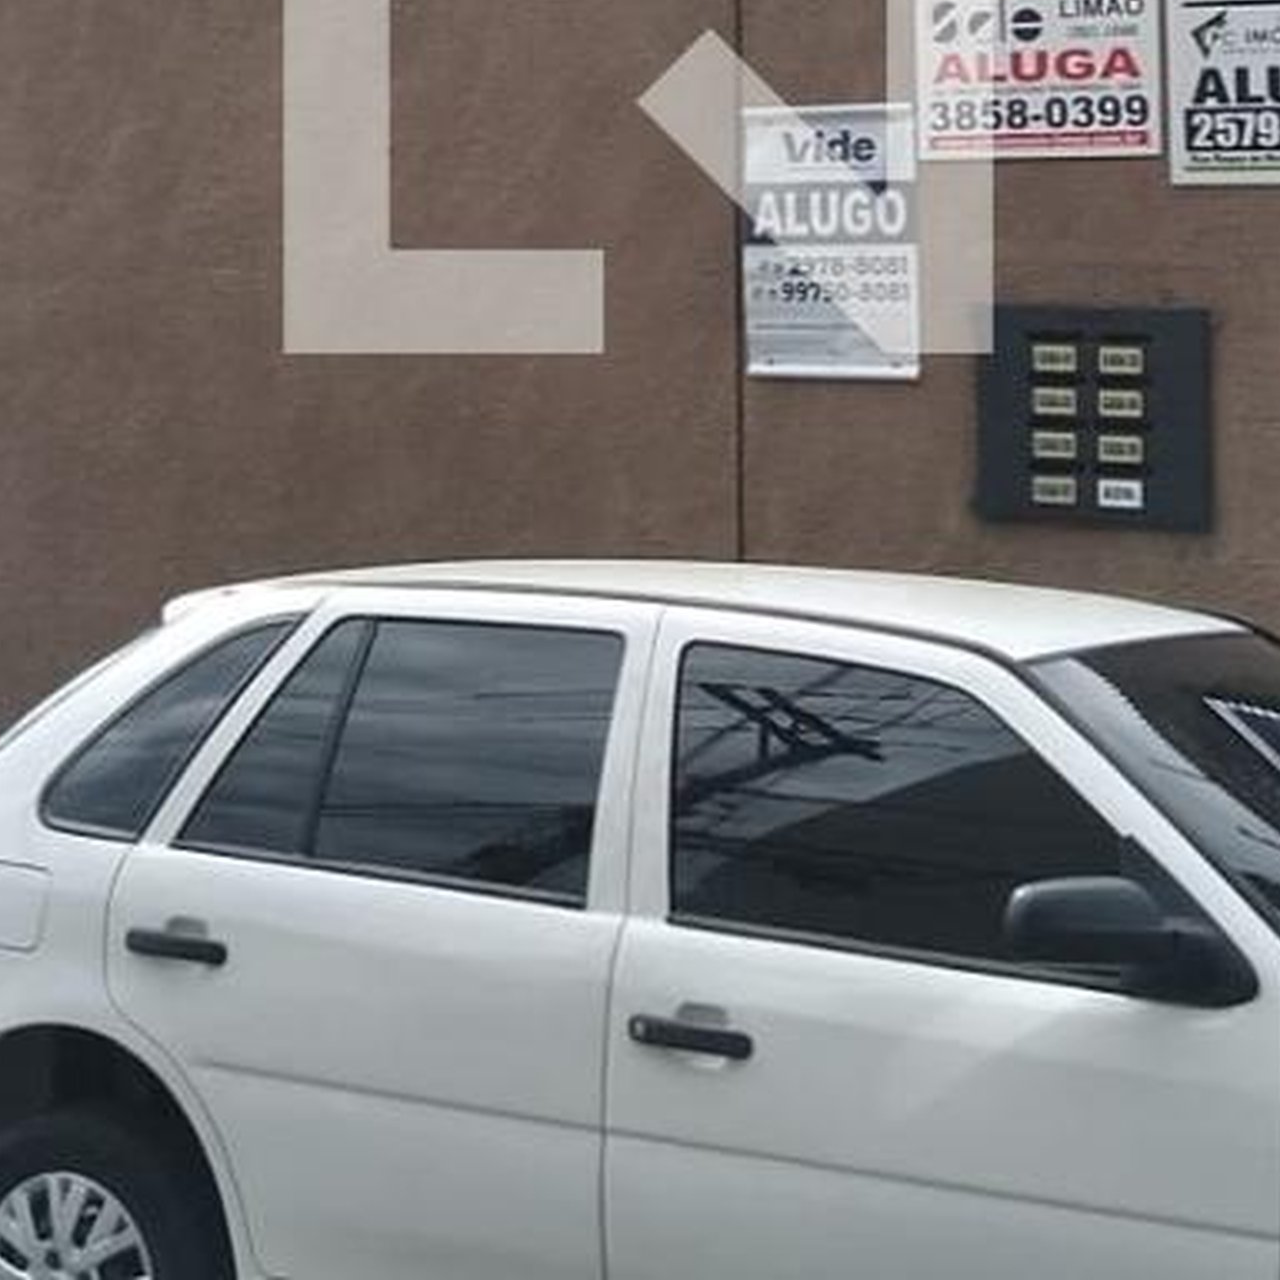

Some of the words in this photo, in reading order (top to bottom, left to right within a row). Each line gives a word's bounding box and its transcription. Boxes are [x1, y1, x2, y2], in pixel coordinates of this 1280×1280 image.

[933, 48, 1142, 84] ALUGA
[930, 94, 1149, 132] 3858-0399
[781, 130, 876, 164] Vide
[752, 189, 908, 237] ALUGO
